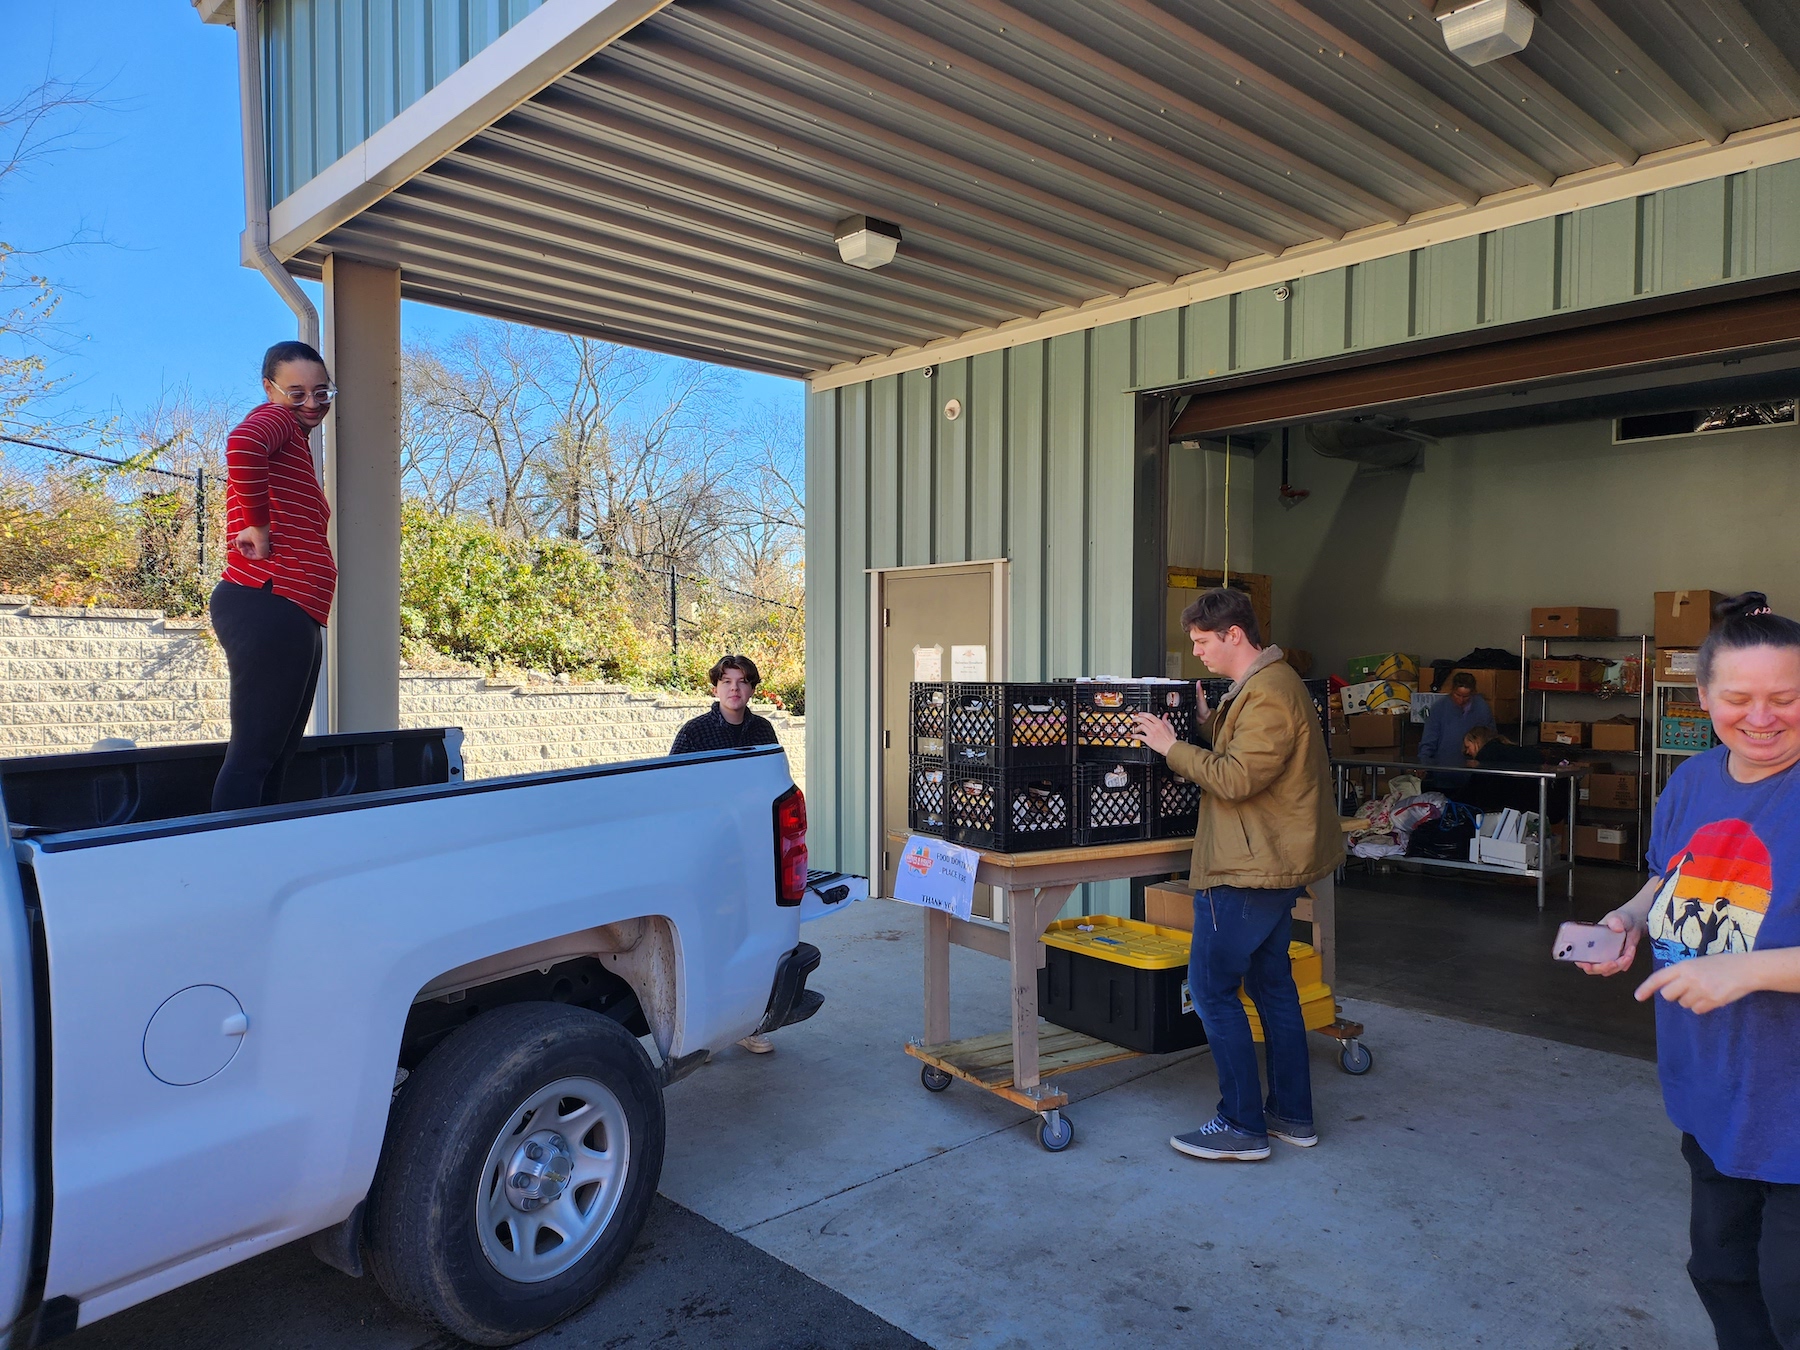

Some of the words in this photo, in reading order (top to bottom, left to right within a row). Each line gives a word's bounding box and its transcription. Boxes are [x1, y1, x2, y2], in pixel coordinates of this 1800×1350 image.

[936, 852, 950, 863] FOOD
[942, 866, 958, 879] PLACE
[921, 894, 943, 906] THANK
